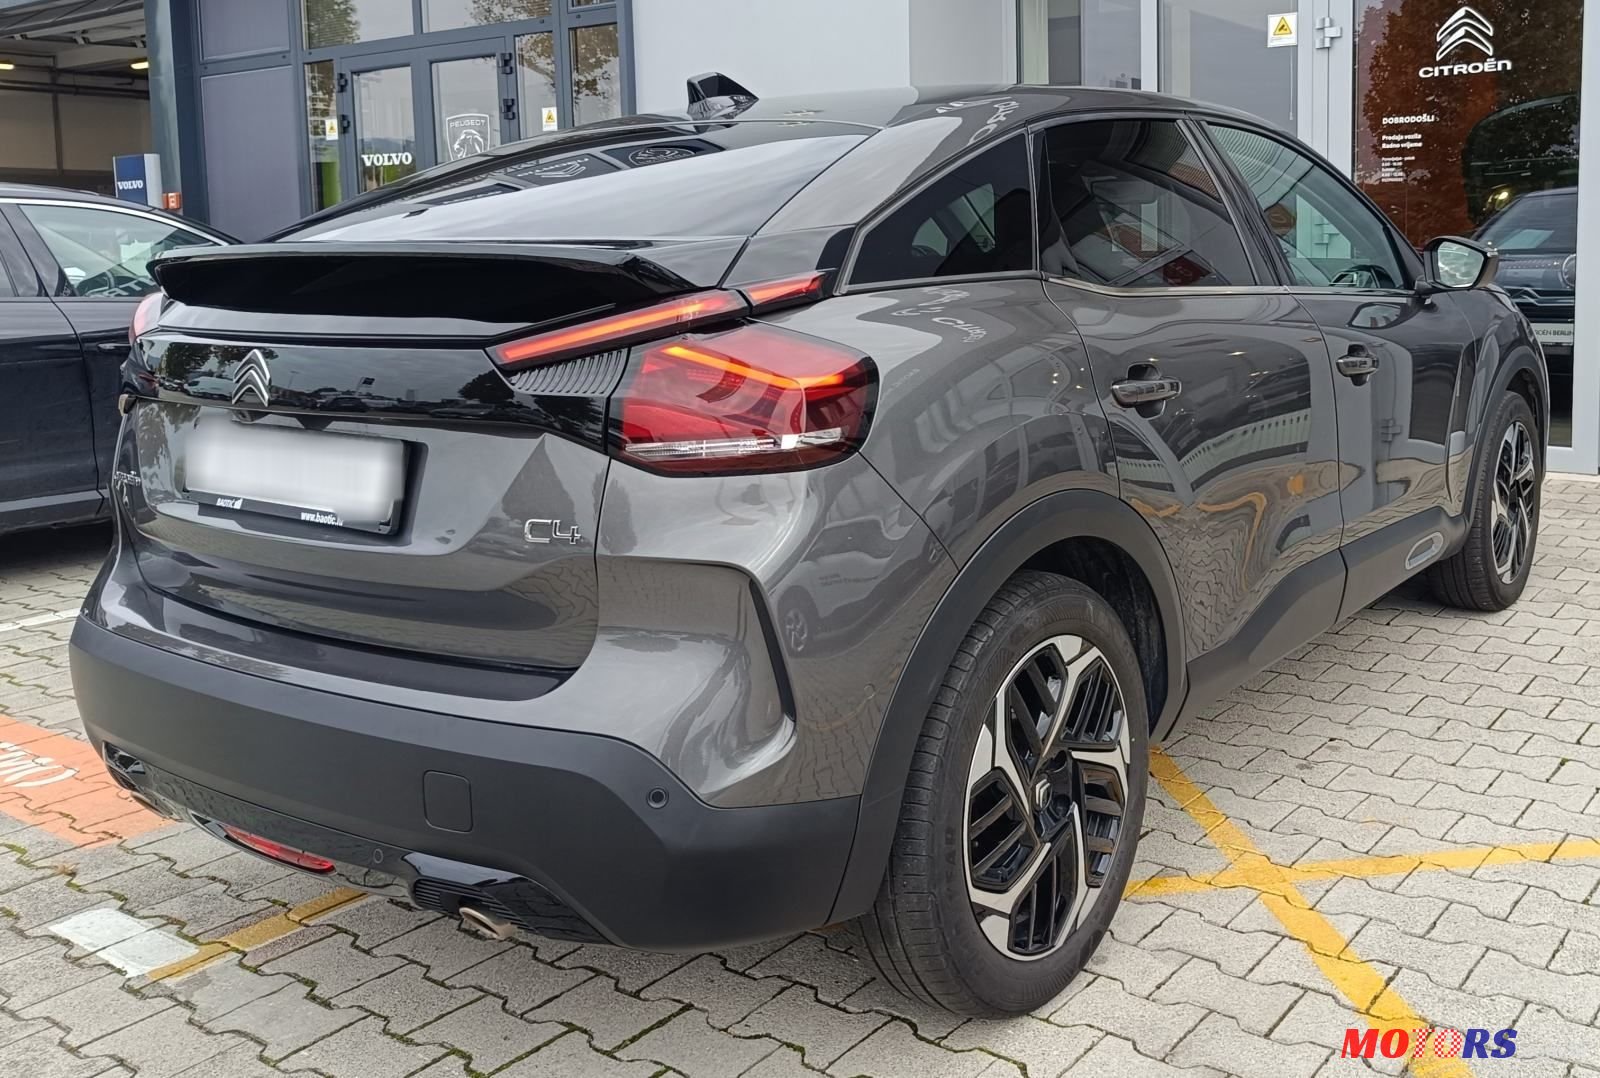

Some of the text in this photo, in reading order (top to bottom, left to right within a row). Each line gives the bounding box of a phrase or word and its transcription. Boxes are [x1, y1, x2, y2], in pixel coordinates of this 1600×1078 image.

[450, 119, 486, 128] PEUGEOT
[1382, 113, 1434, 124] DOBRODOŠLI
[361, 152, 412, 166] VOLVO
[117, 180, 143, 190] VOLVO
[524, 518, 581, 544] C4
